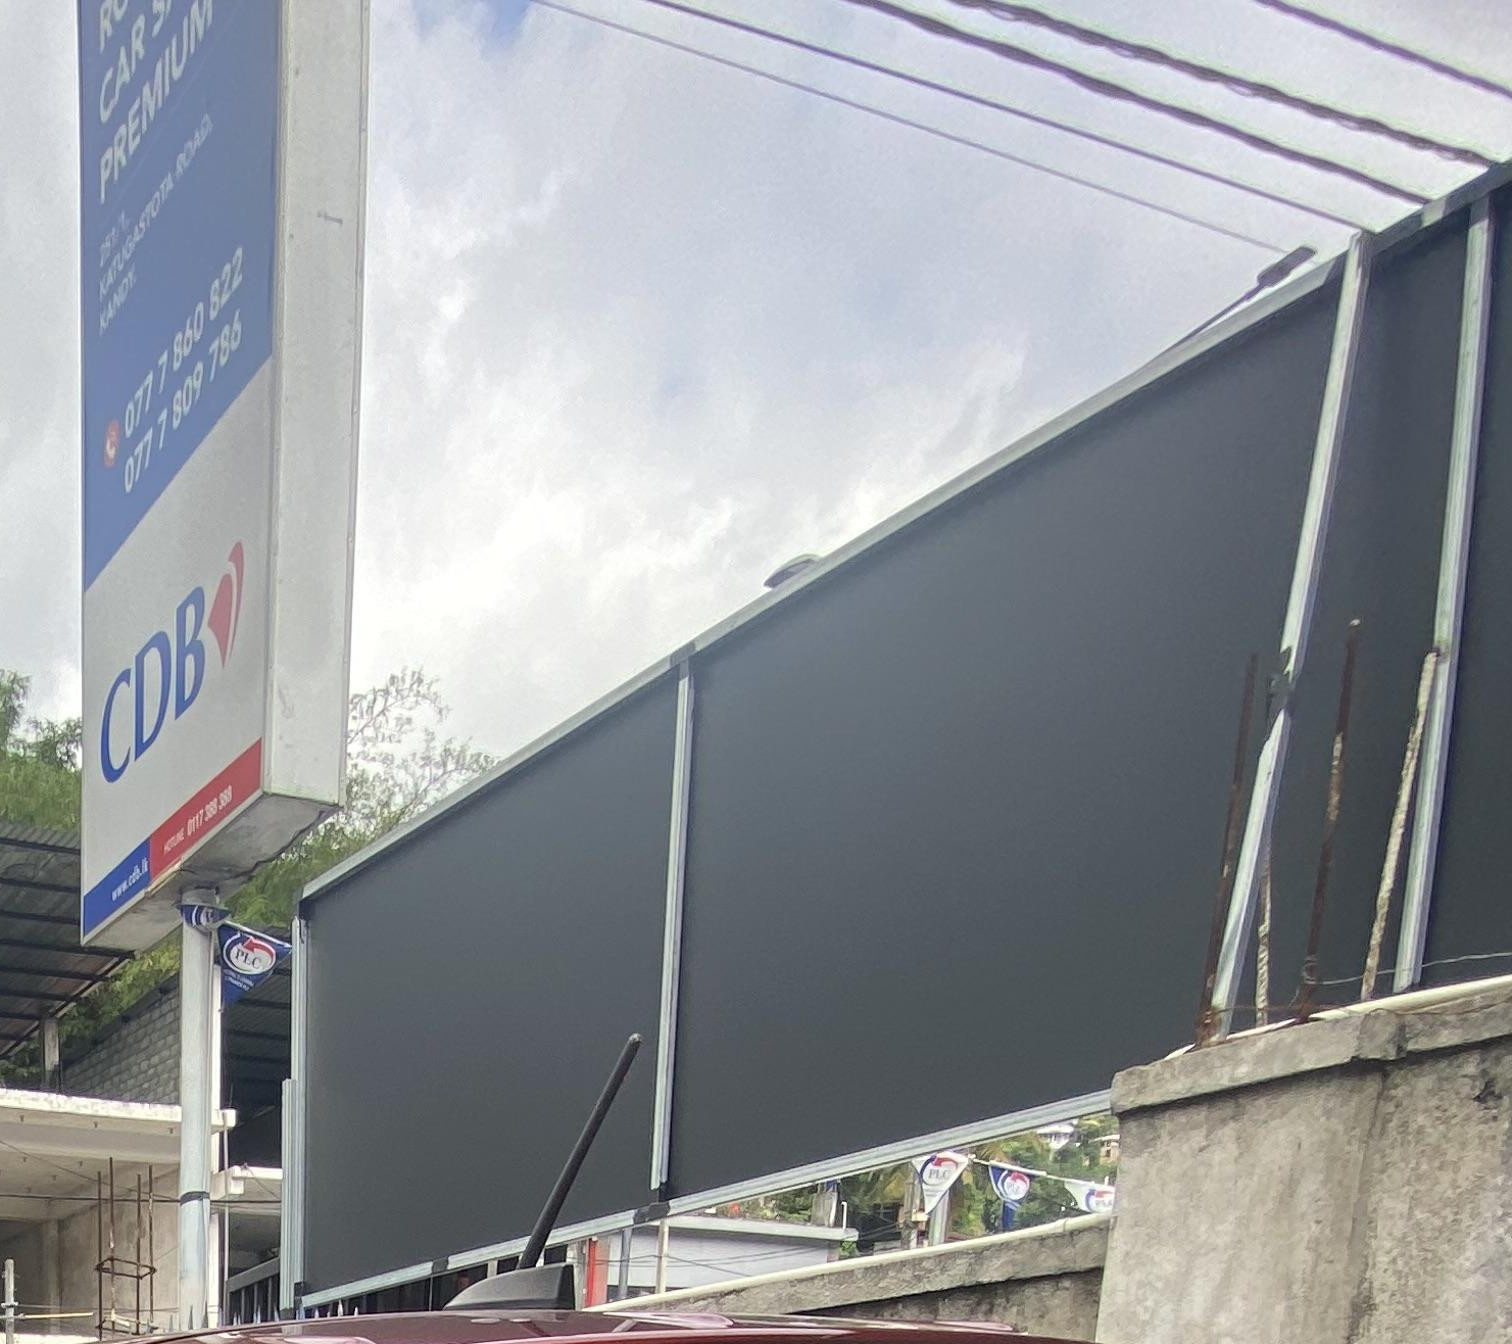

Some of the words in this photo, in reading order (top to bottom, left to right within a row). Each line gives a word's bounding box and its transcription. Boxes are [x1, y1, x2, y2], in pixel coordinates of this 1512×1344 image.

[99, 13, 146, 124] CAR
[100, 0, 213, 205] PREMIUM
[124, 369, 154, 439] 077
[157, 350, 168, 394] 7
[172, 301, 204, 372] 860
[209, 247, 243, 321] 822
[124, 427, 154, 493] 077
[157, 407, 168, 450] 7
[172, 360, 204, 431] 809
[208, 307, 242, 383] 786
[100, 586, 206, 784] CDB
[234, 948, 263, 970] PLC
[928, 1168, 952, 1180] PLC
